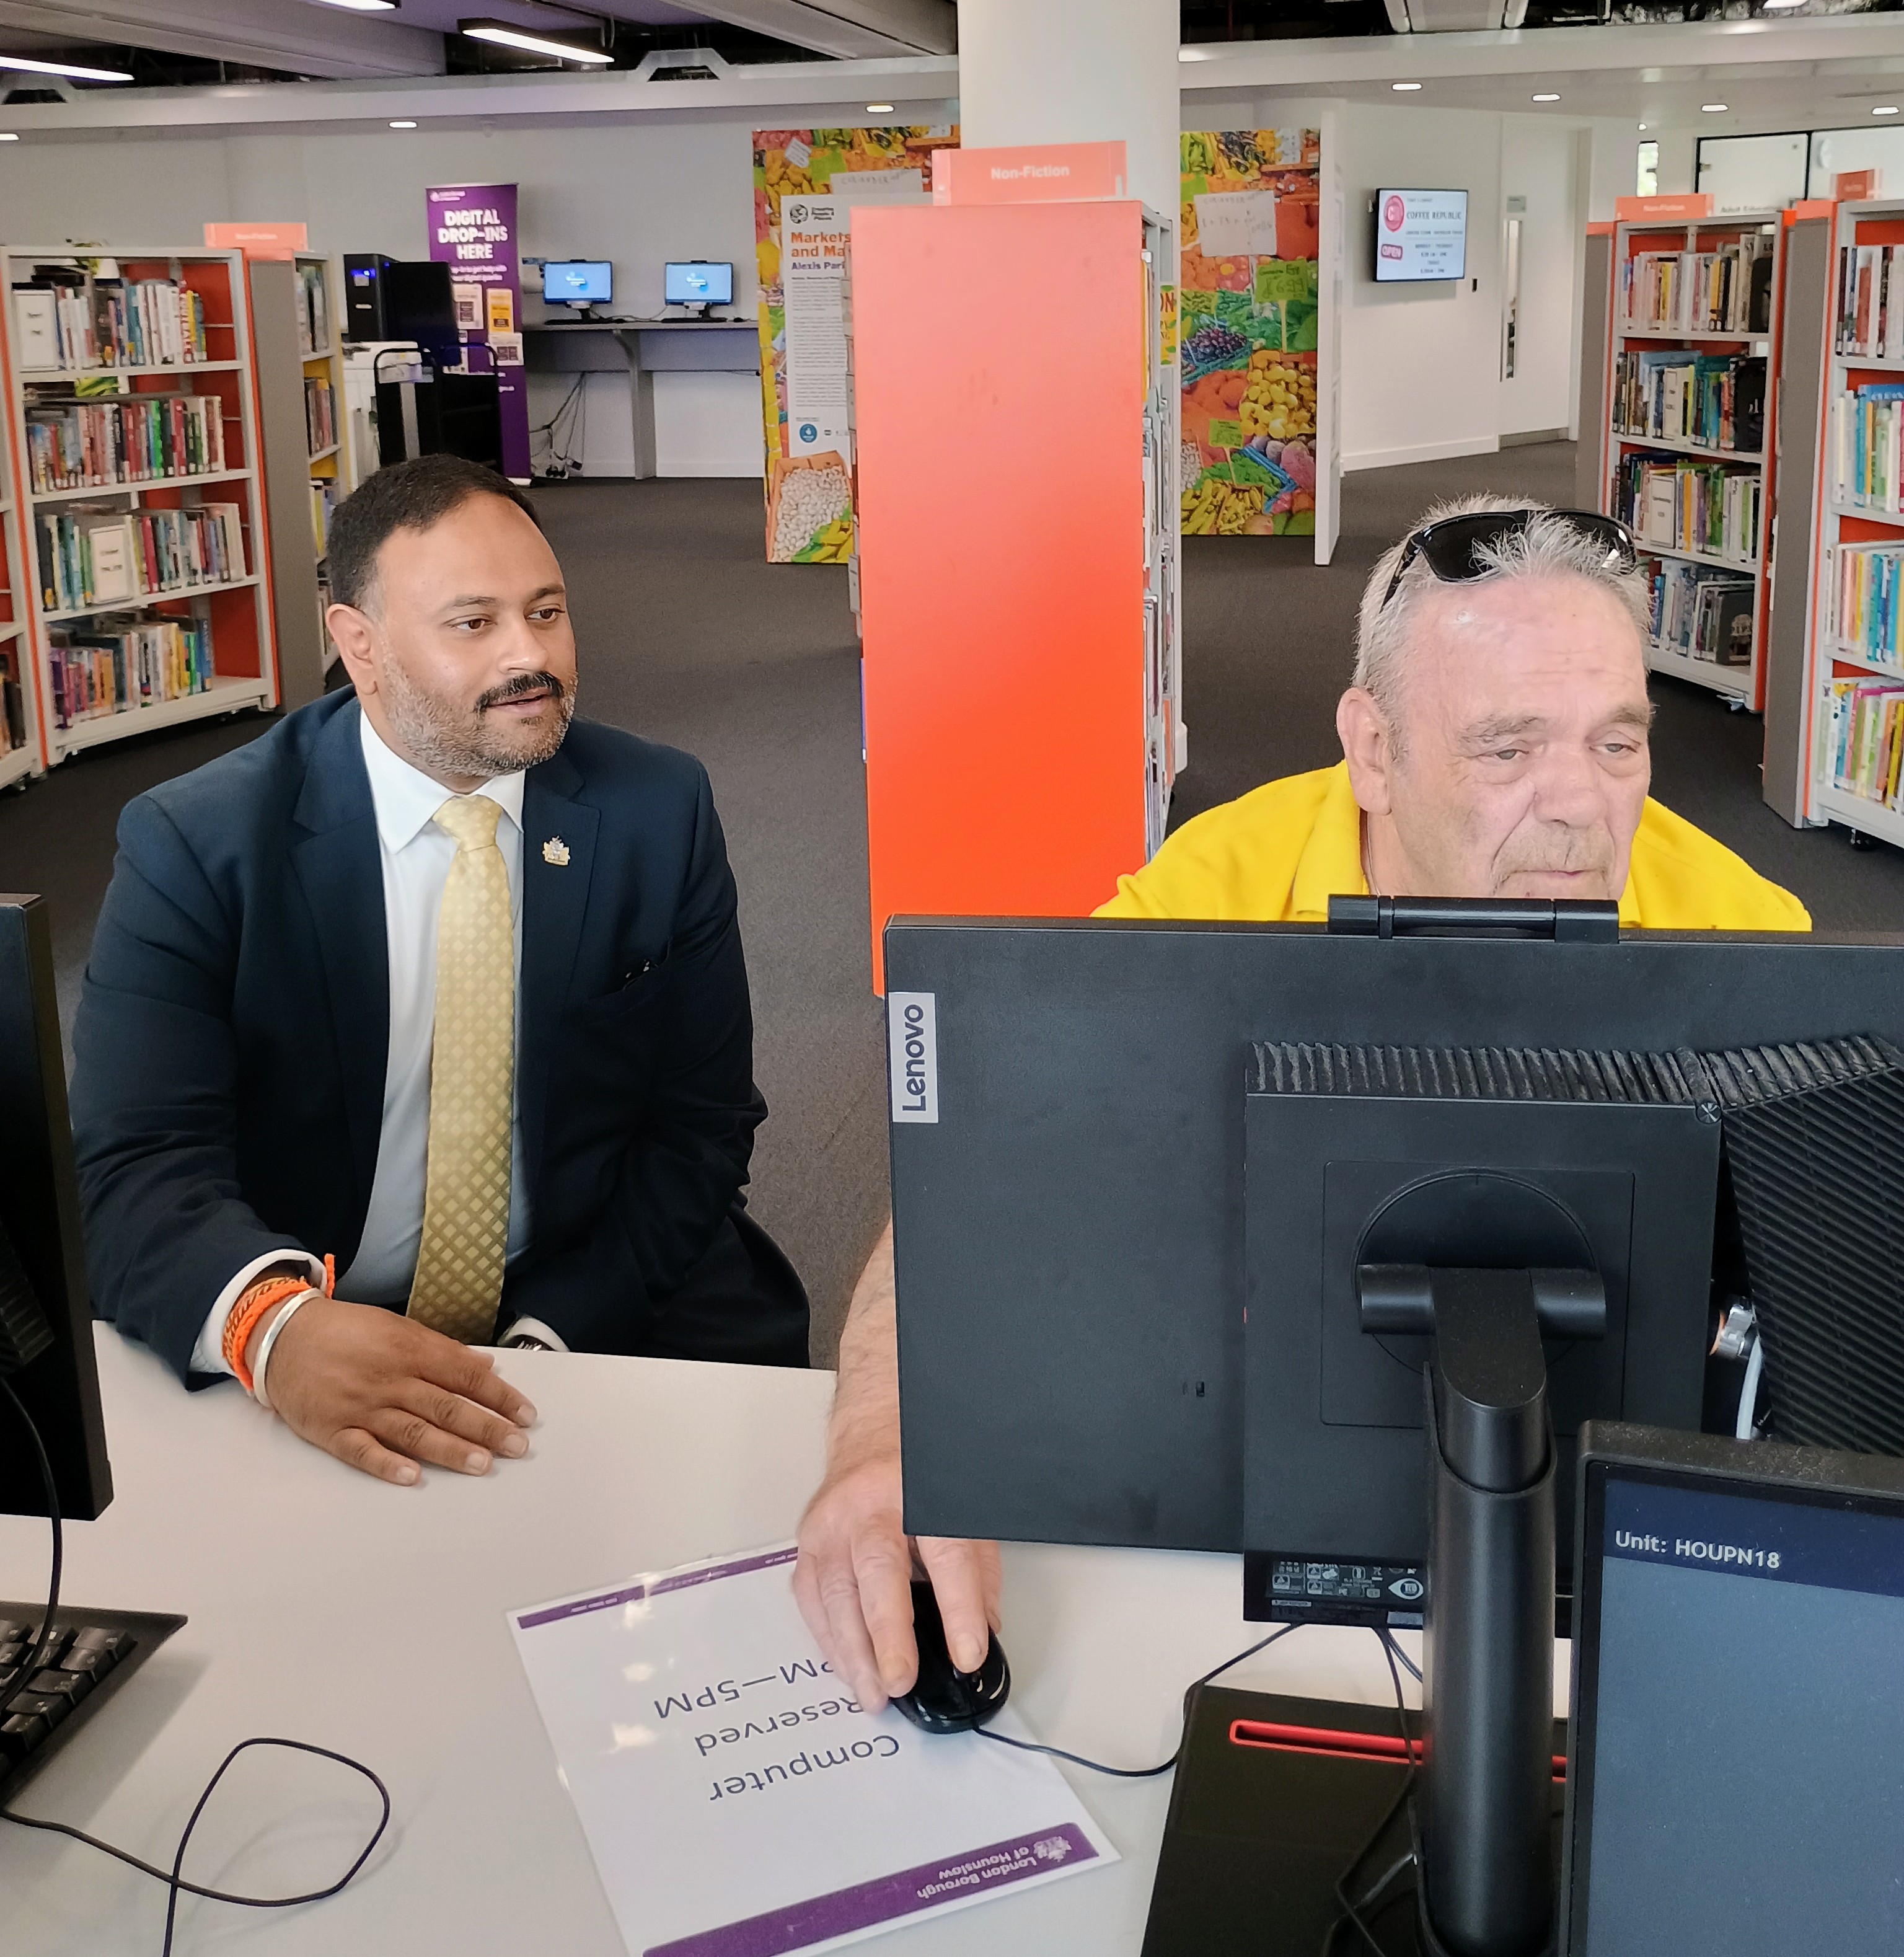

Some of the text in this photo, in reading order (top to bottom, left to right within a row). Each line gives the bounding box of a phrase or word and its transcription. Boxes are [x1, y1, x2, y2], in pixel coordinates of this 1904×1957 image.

[991, 166, 1070, 180] Non-Fiction
[444, 209, 501, 226] DIGITAL
[1406, 211, 1462, 220] COFFEE REPUBLIC
[438, 226, 508, 244] DROP-INS
[791, 231, 851, 243] Markets
[456, 244, 493, 259] HERE
[791, 245, 845, 257] and Ma
[1382, 245, 1401, 258] OPEN
[791, 261, 845, 270] Alexis Pari
[902, 1004, 927, 1111] Lenovo
[1615, 1530, 1781, 1570] Unit: HOUPN18
[694, 1696, 863, 1757] Reserved
[710, 1734, 900, 1801] Computer
[938, 1846, 1029, 1880] of Hounslow
[917, 1856, 1038, 1899] London Borough
